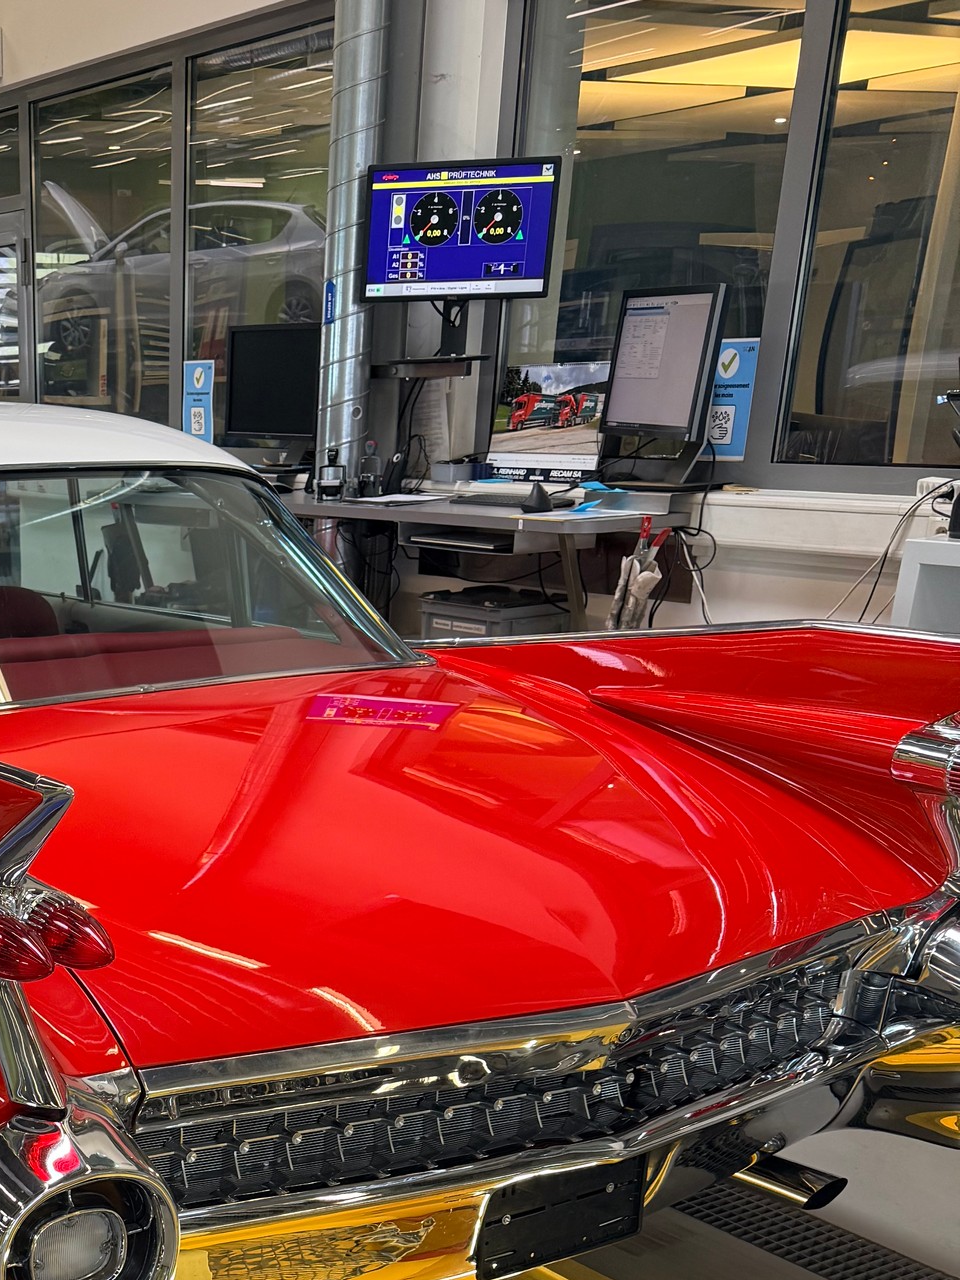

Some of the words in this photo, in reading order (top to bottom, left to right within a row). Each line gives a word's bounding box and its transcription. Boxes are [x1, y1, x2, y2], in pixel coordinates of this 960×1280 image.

[425, 172, 441, 180] AHS
[448, 169, 497, 179] PRÜFTECHNIK
[426, 229, 441, 238] 0,00
[489, 227, 505, 236] 0,00
[498, 468, 528, 476] REINHARD
[549, 469, 573, 478] RECAM
[573, 470, 582, 478] SA
